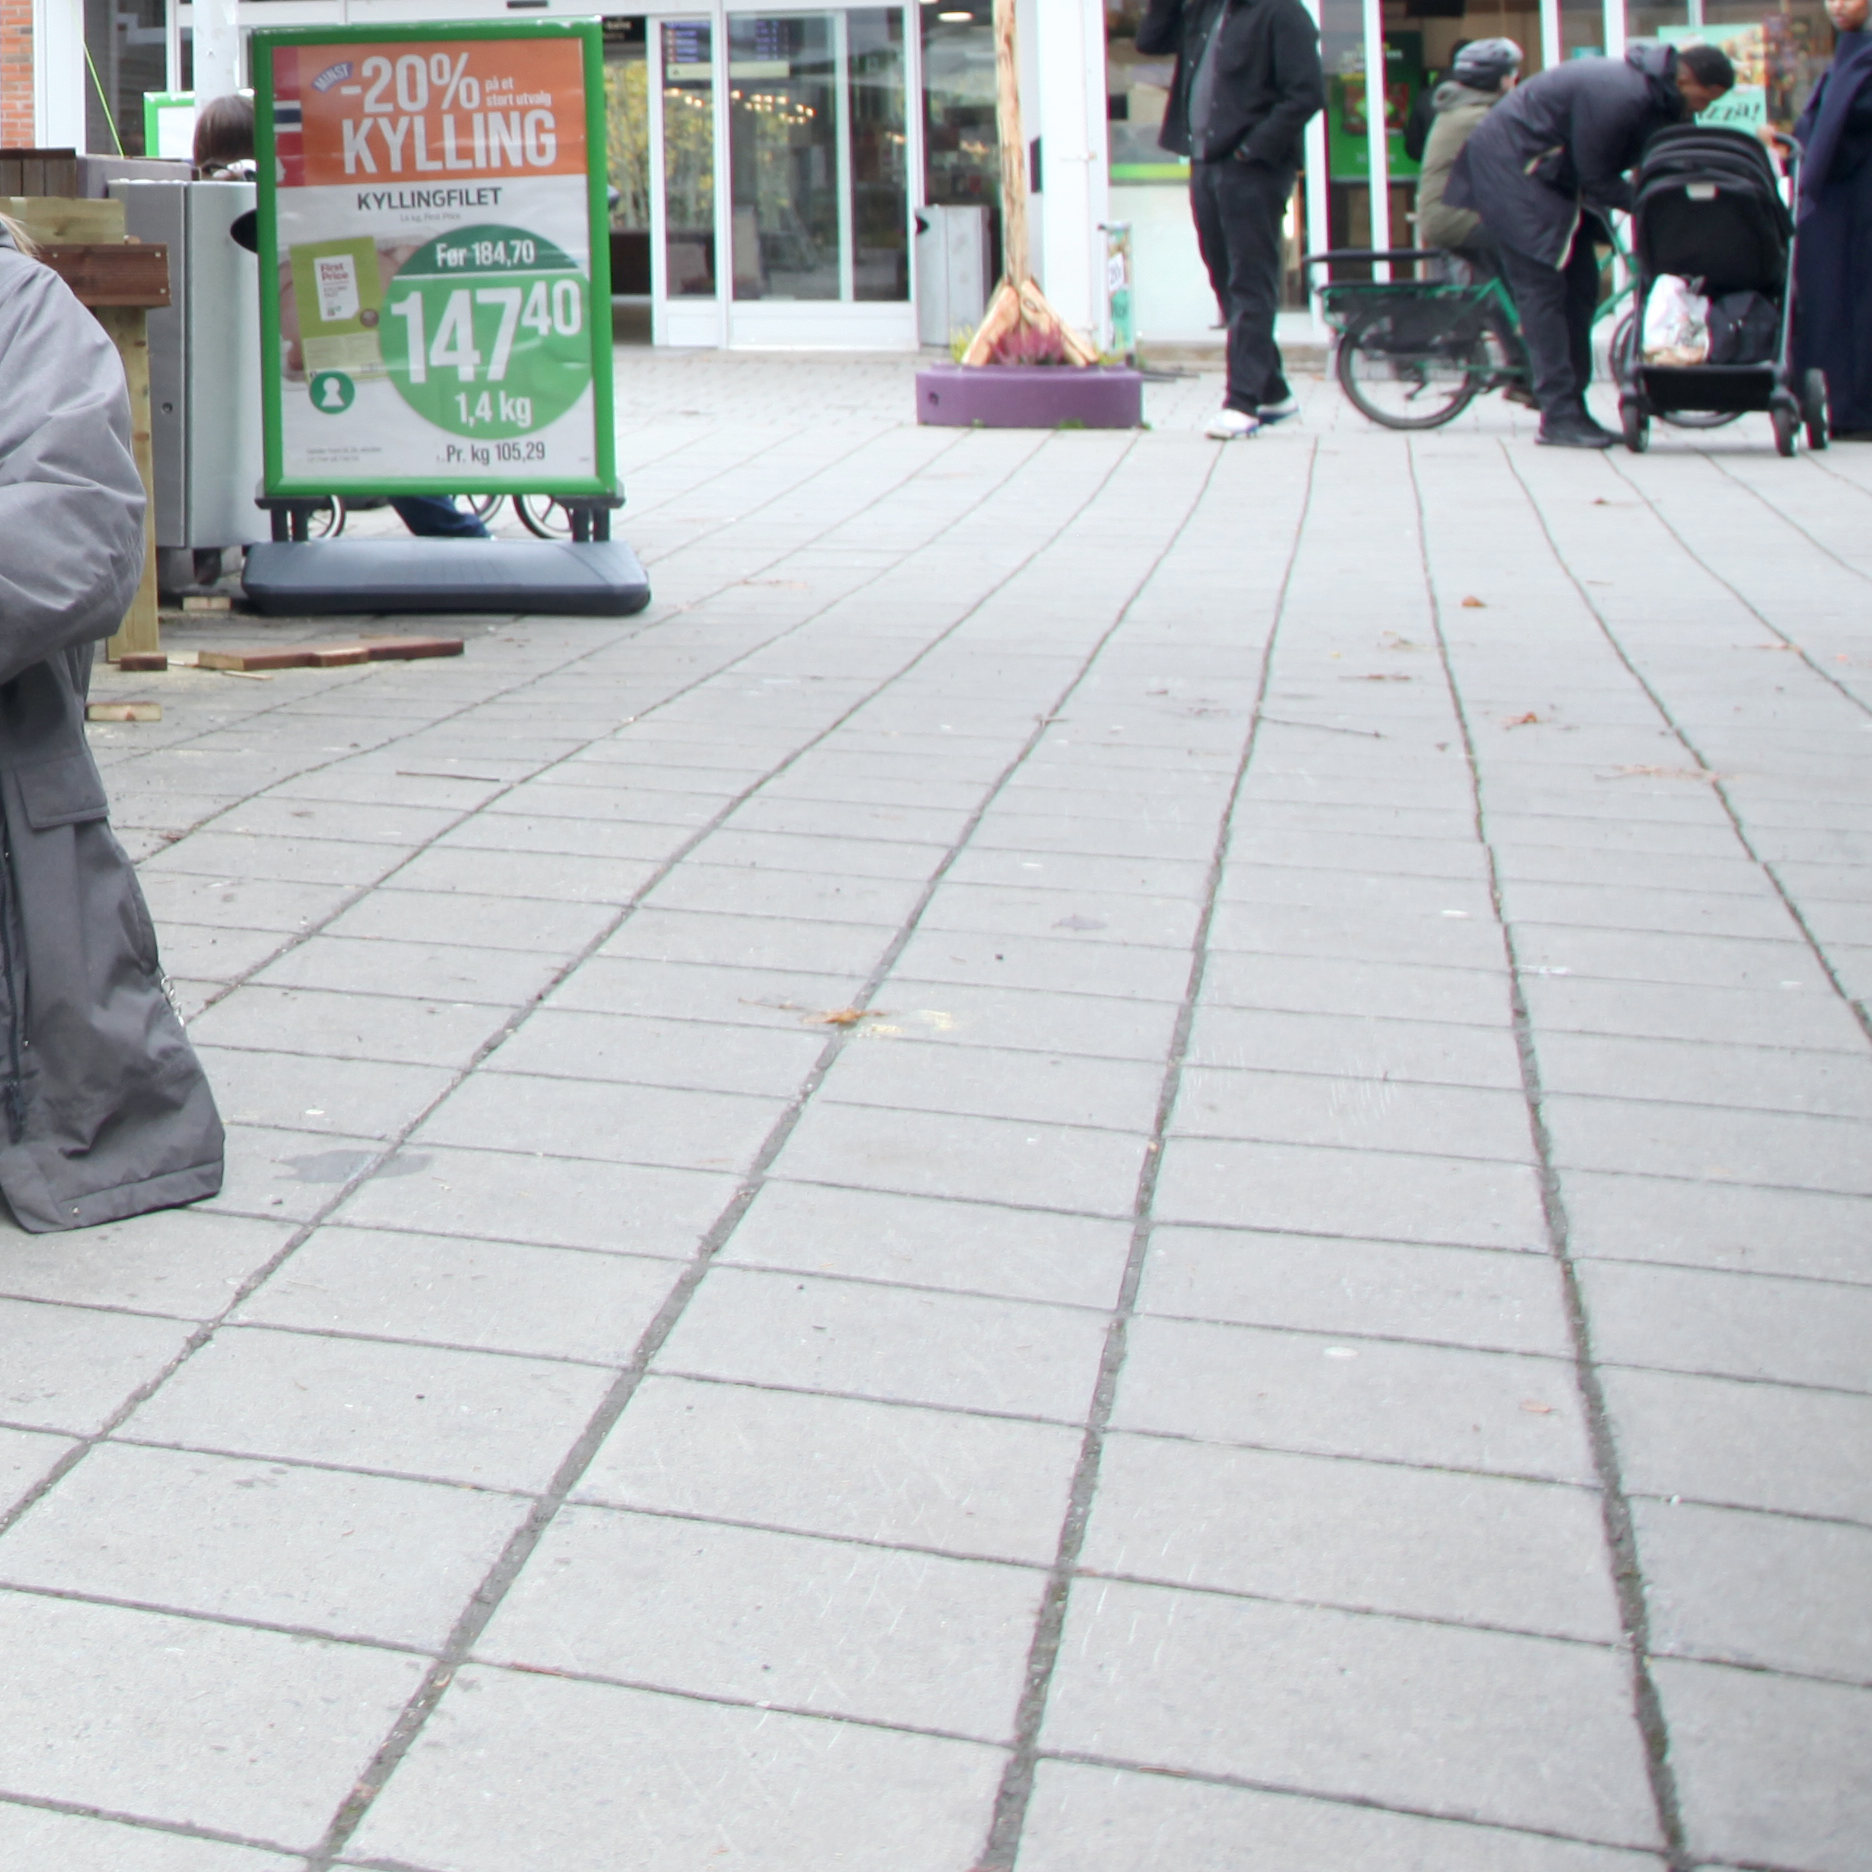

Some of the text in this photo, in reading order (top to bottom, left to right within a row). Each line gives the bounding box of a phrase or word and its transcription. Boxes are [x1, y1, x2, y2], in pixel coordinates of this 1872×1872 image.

[315, 62, 351, 91] MINST
[340, 52, 480, 113] -20%
[486, 91, 552, 107] stort utvalg
[342, 109, 557, 174] KYLLING
[357, 188, 502, 211] KYLLINGFILET
[436, 239, 535, 268] Før 184,70
[455, 390, 533, 428] 1,4 kg
[446, 442, 546, 466] Pr. kg 105,29
